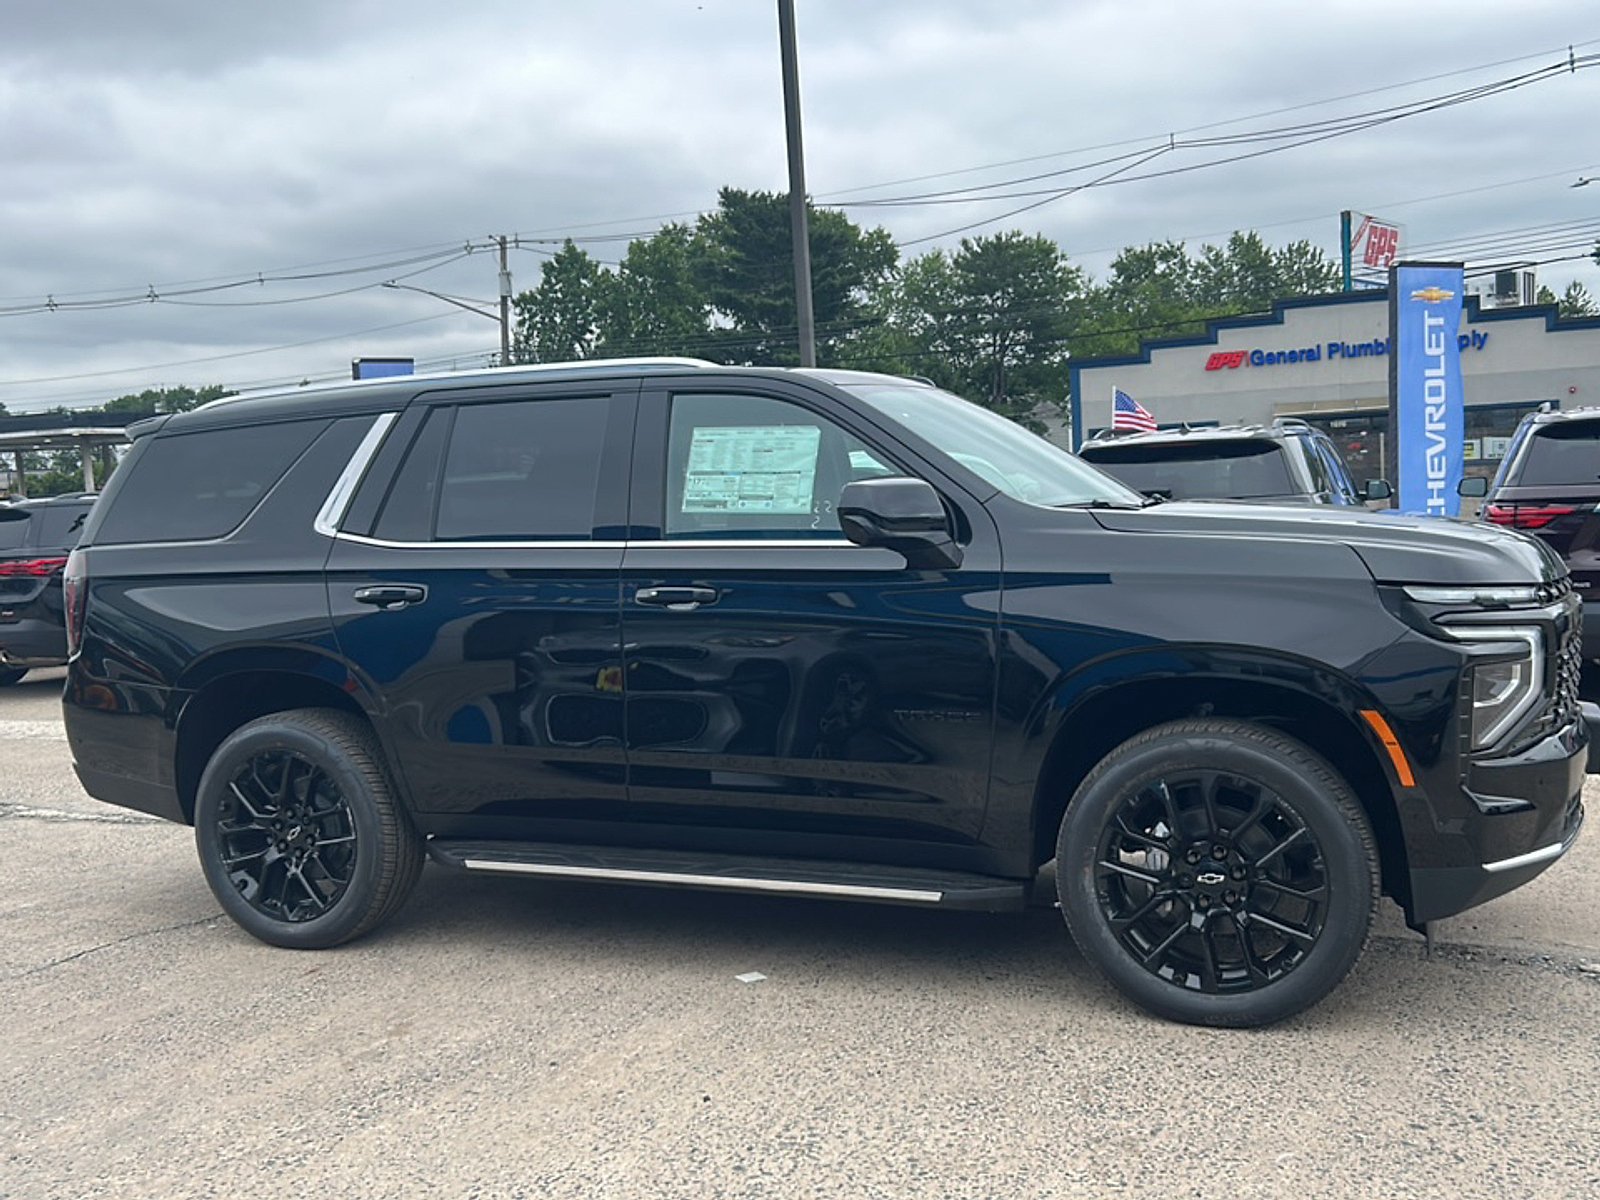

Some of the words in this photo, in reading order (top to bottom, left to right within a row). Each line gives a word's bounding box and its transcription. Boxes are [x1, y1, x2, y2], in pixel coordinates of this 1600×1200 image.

[1364, 226, 1398, 268] GPS
[1205, 350, 1245, 371] GPS
[1250, 344, 1322, 367] General
[1327, 337, 1391, 360] Plumbi
[1457, 329, 1489, 353] ply
